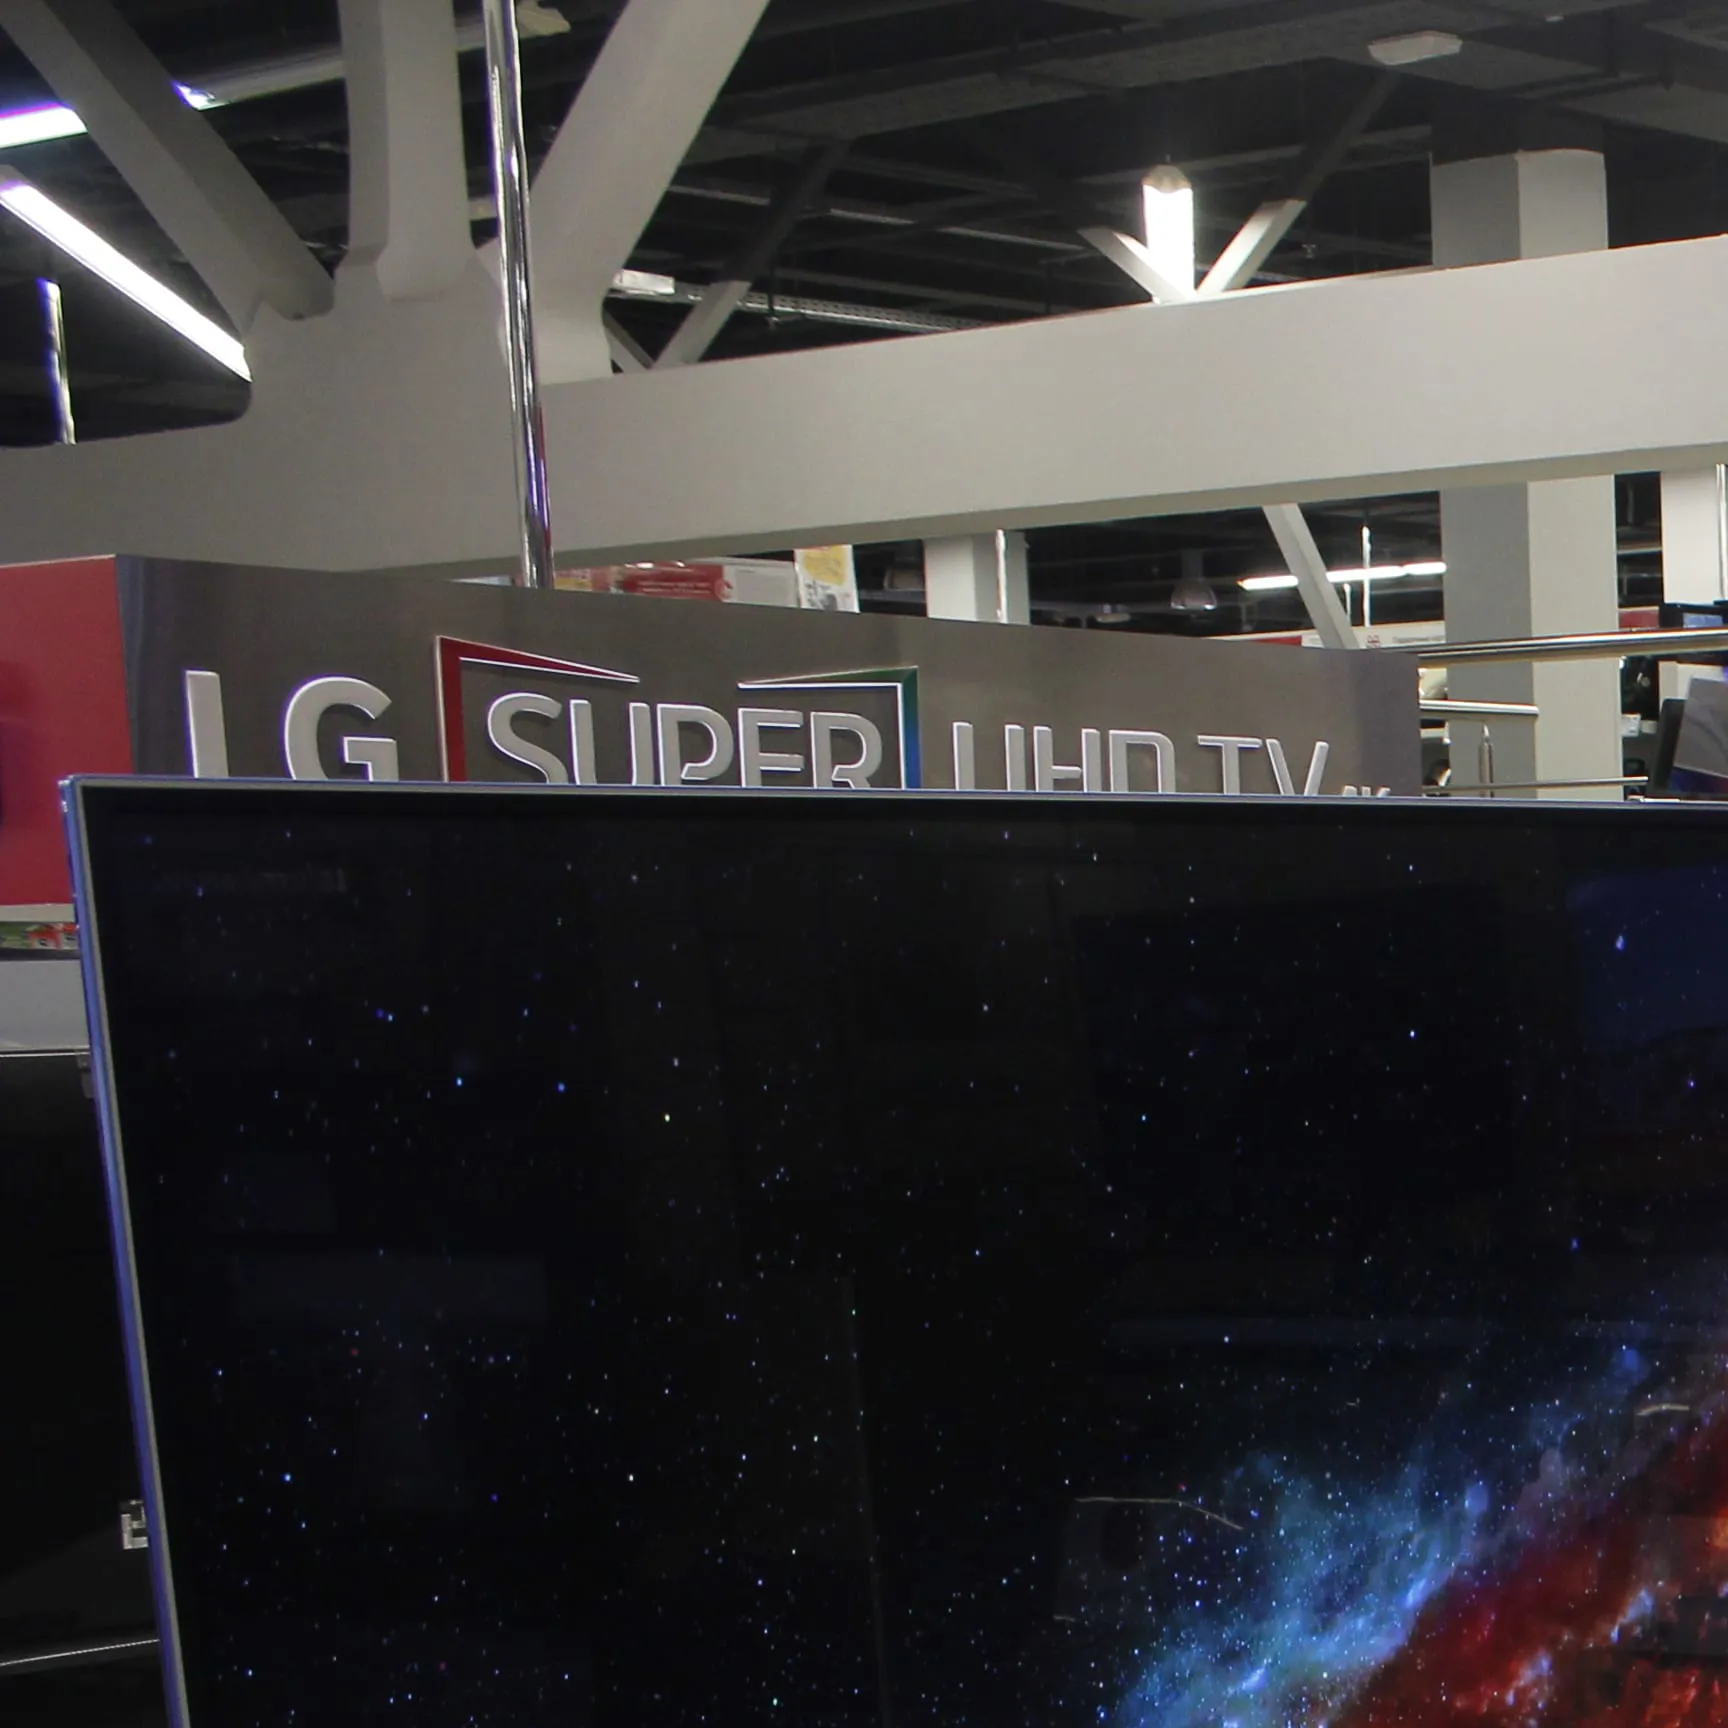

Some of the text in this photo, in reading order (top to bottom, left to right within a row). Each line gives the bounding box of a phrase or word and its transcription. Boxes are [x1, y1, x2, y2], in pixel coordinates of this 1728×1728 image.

[184, 670, 1329, 797] LG SUPER UHD TV
